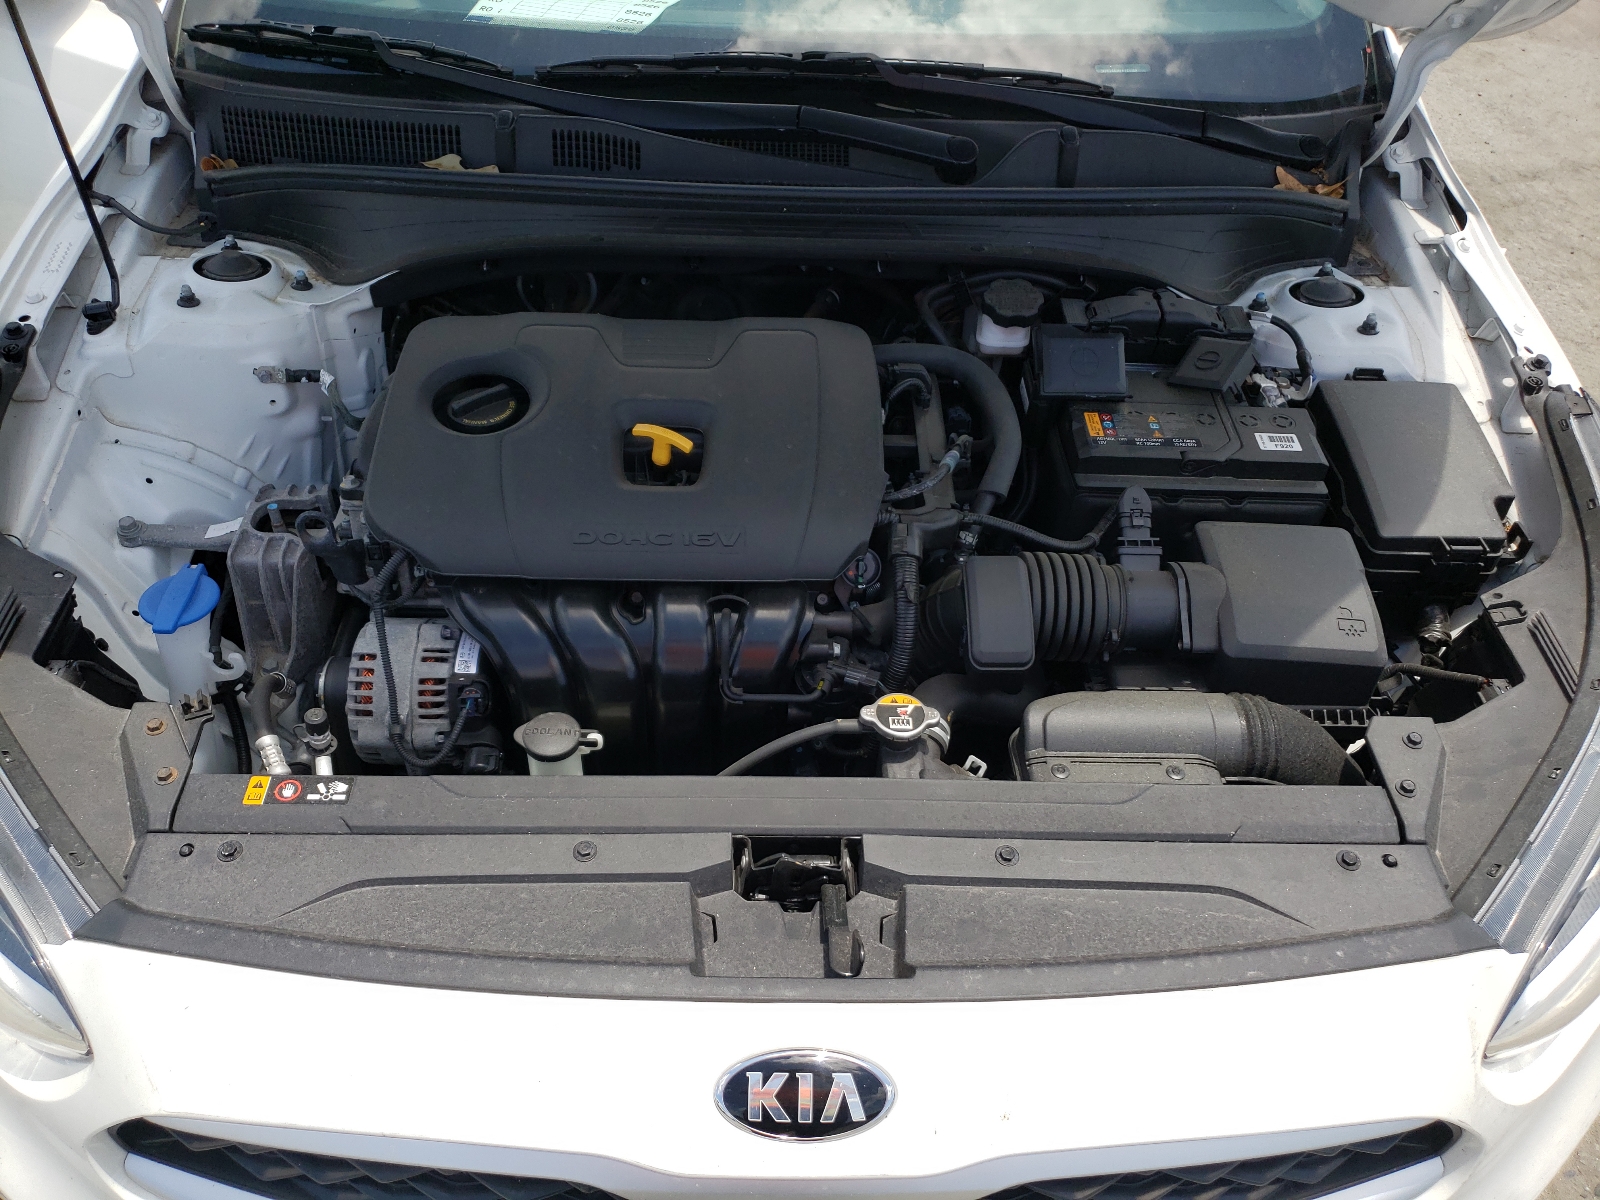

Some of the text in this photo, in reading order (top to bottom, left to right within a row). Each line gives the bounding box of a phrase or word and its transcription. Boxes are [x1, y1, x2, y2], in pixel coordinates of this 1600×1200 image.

[571, 531, 742, 548] DOHC 16V
[524, 727, 581, 737] COOLANT
[746, 1071, 866, 1123] KIA
